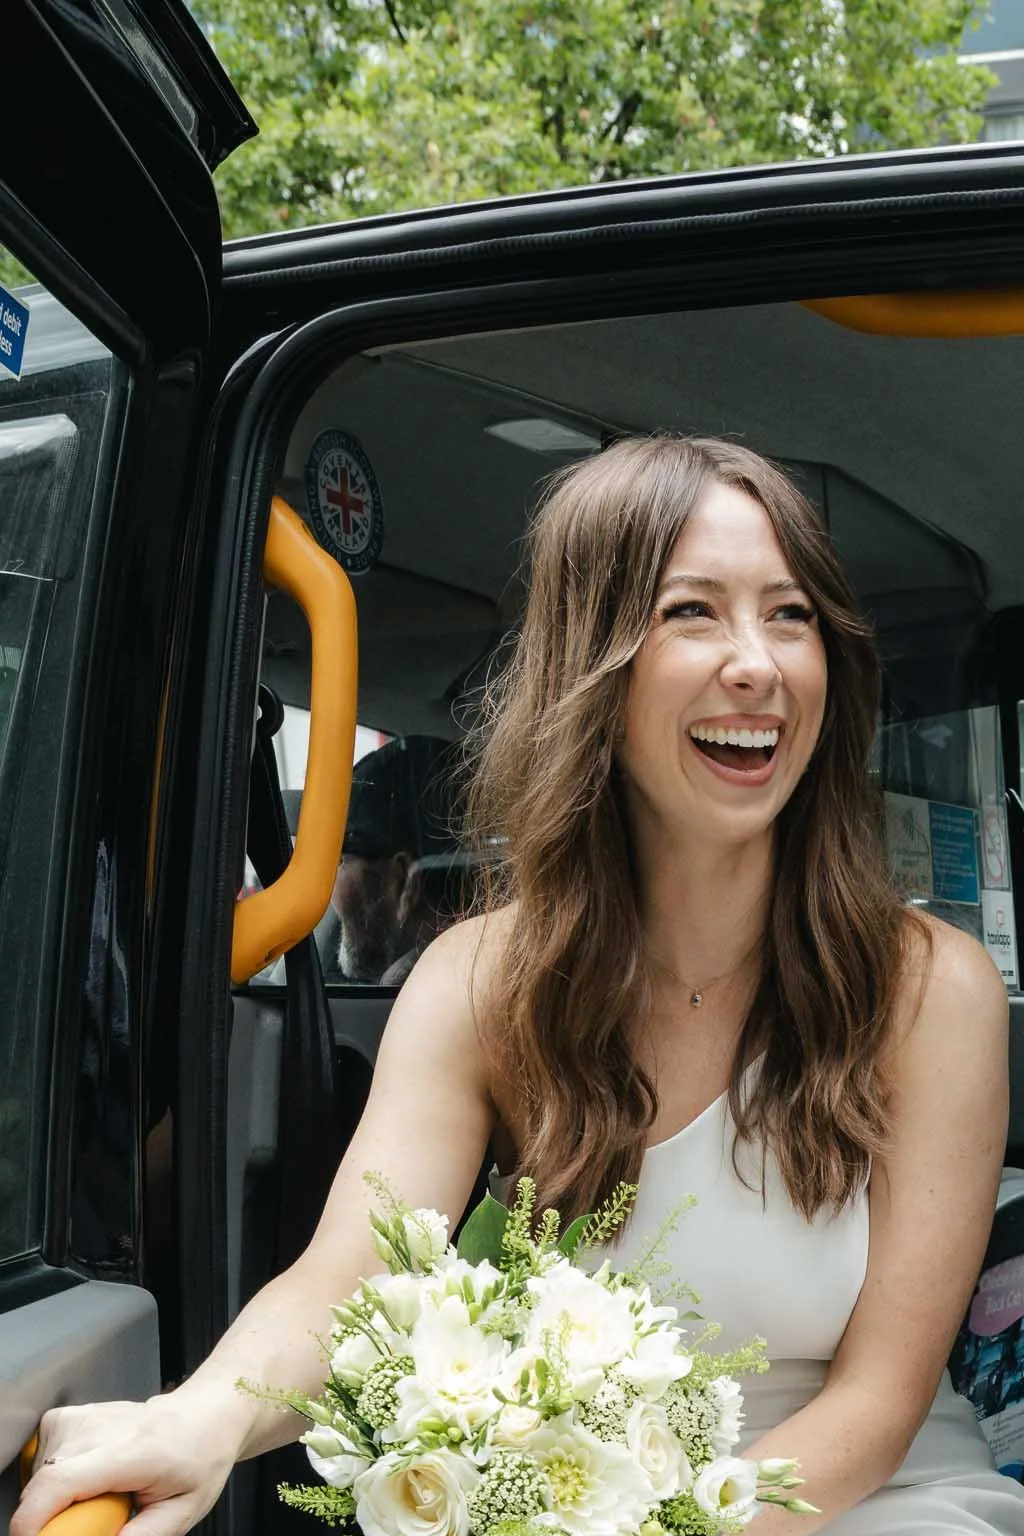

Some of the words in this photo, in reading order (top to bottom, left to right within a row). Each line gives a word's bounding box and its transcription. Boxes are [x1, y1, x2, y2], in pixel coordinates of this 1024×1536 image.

[3, 308, 21, 337] debit
[319, 453, 370, 508] COVENTRY
[322, 504, 369, 547] ENGLAND
